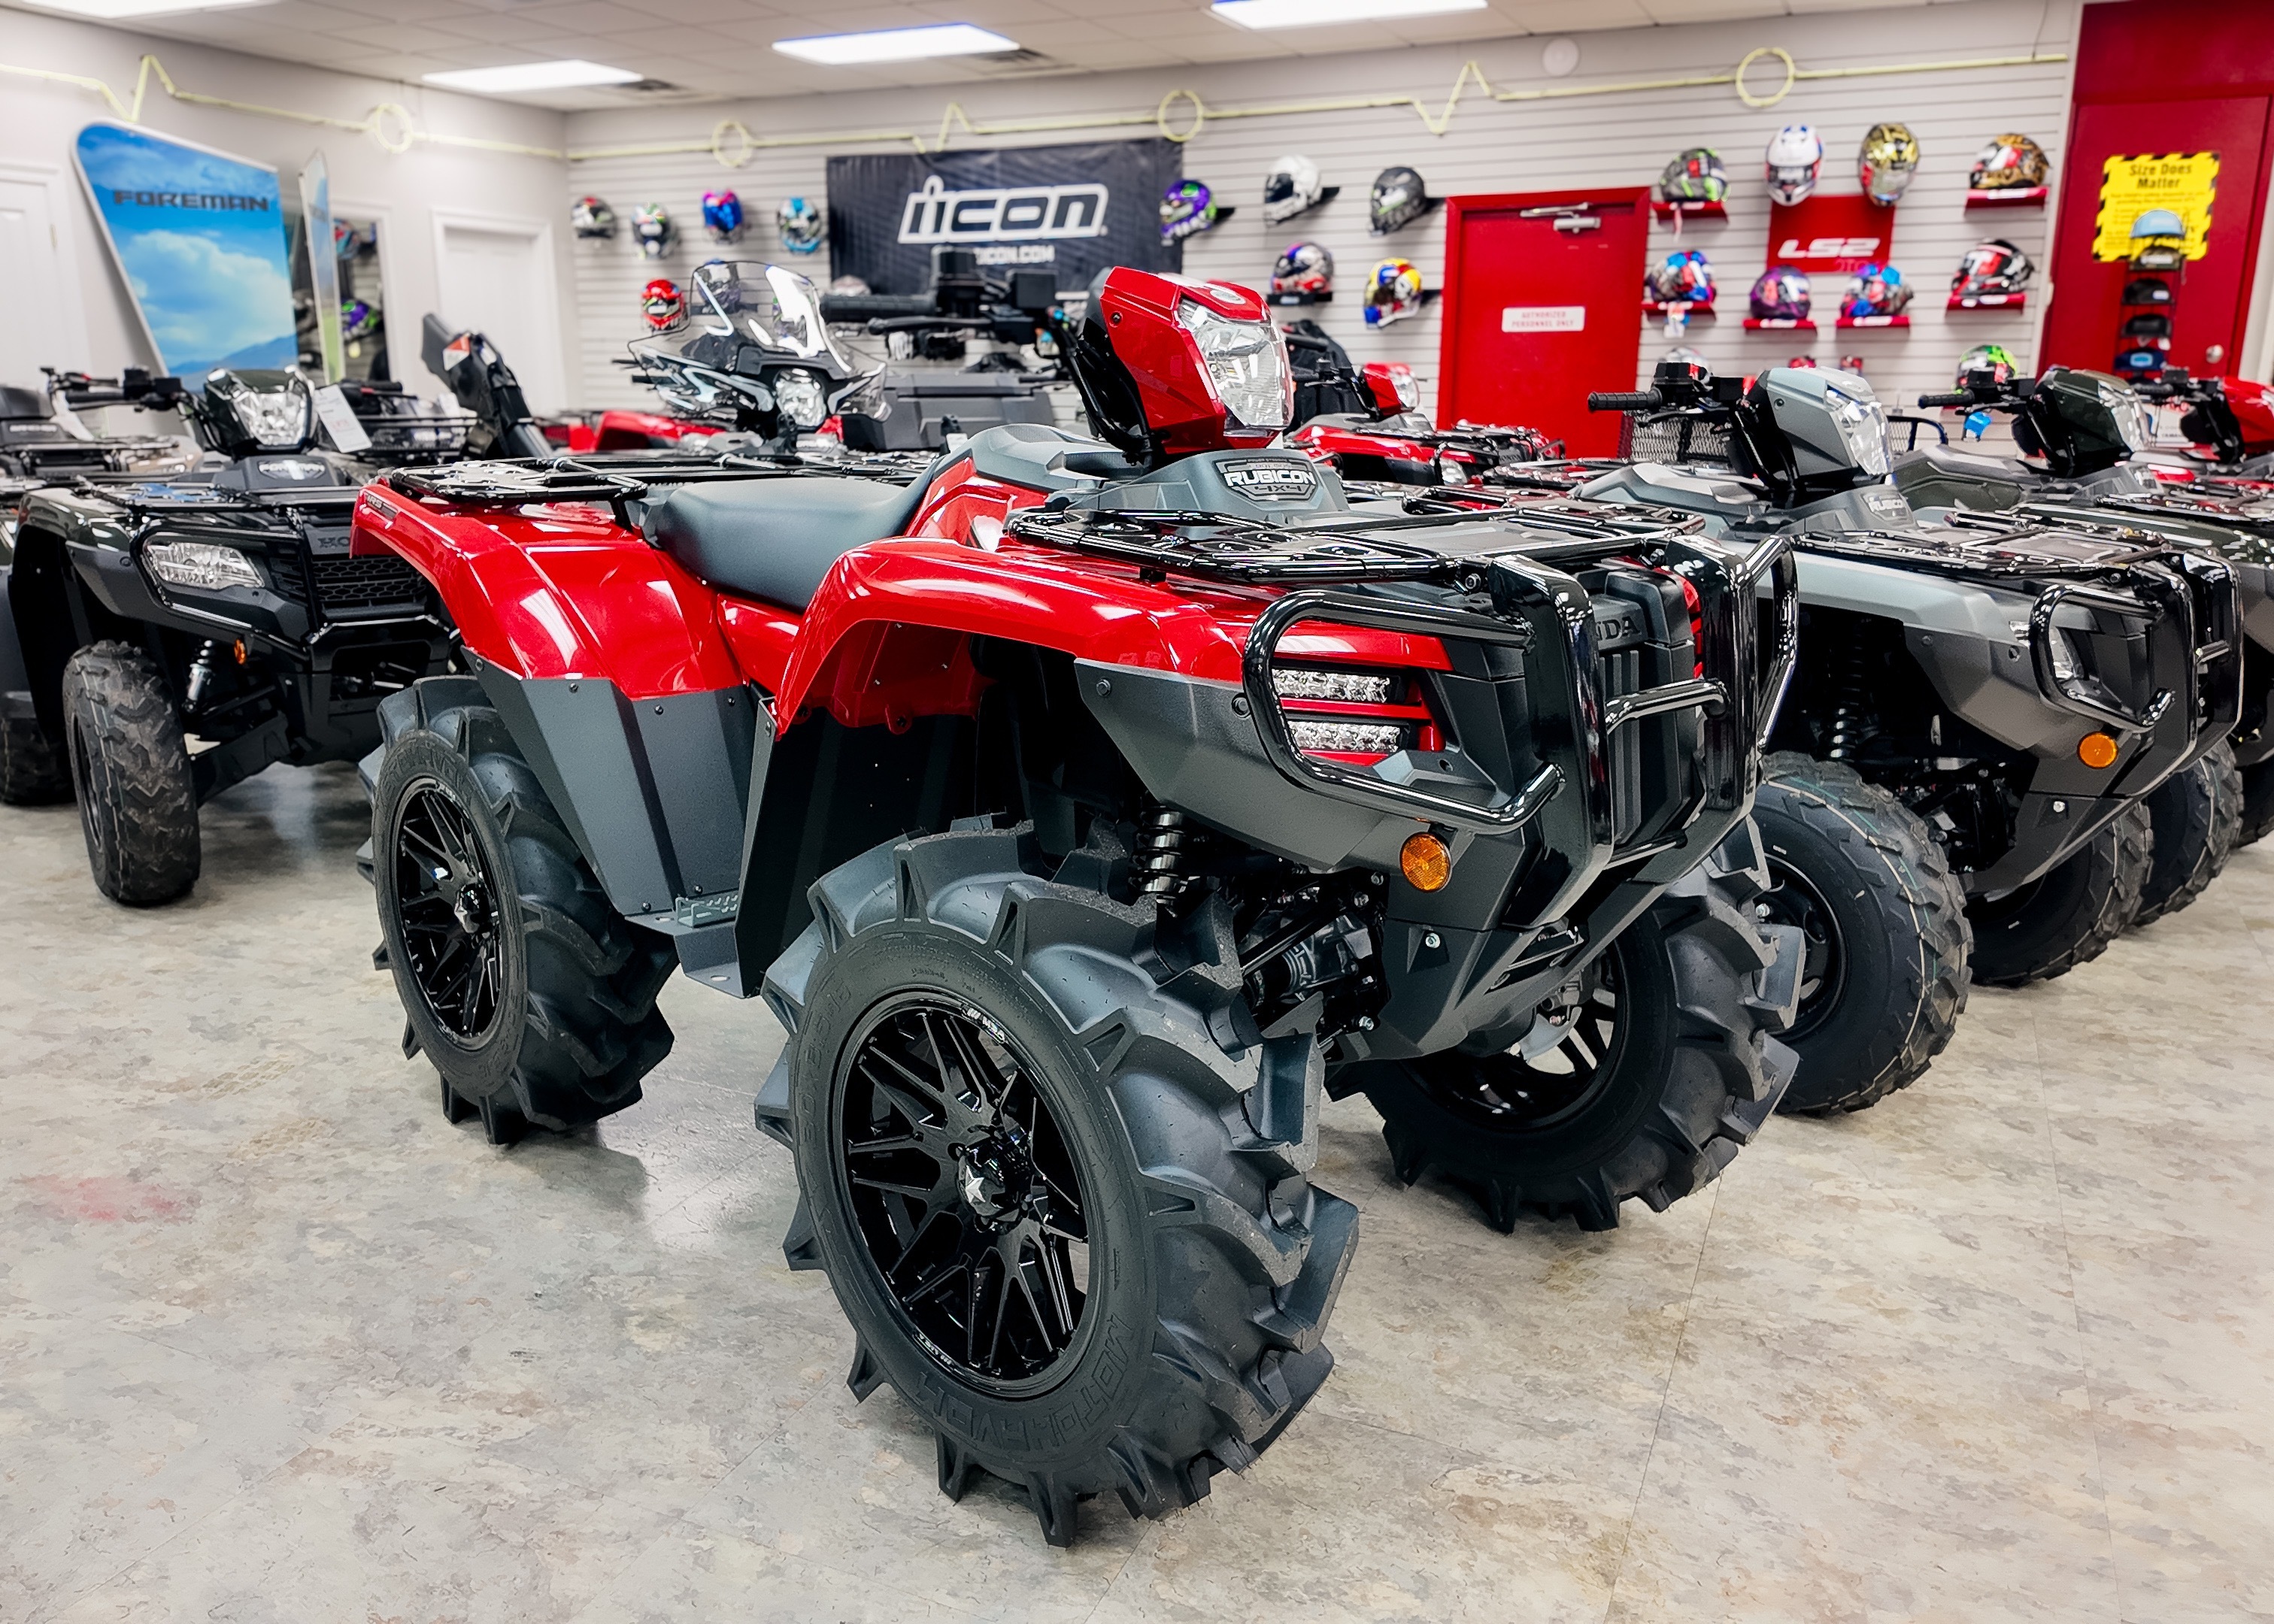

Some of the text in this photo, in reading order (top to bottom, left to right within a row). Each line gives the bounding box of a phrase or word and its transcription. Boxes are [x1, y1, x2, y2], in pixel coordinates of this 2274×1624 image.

[2130, 163, 2193, 176] Size Does
[2136, 177, 2180, 189] Matter
[114, 189, 269, 212] FOREMAN
[1777, 237, 1881, 259] LS2
[1223, 470, 1317, 487] RUBICON
[367, 495, 383, 509] IRS
